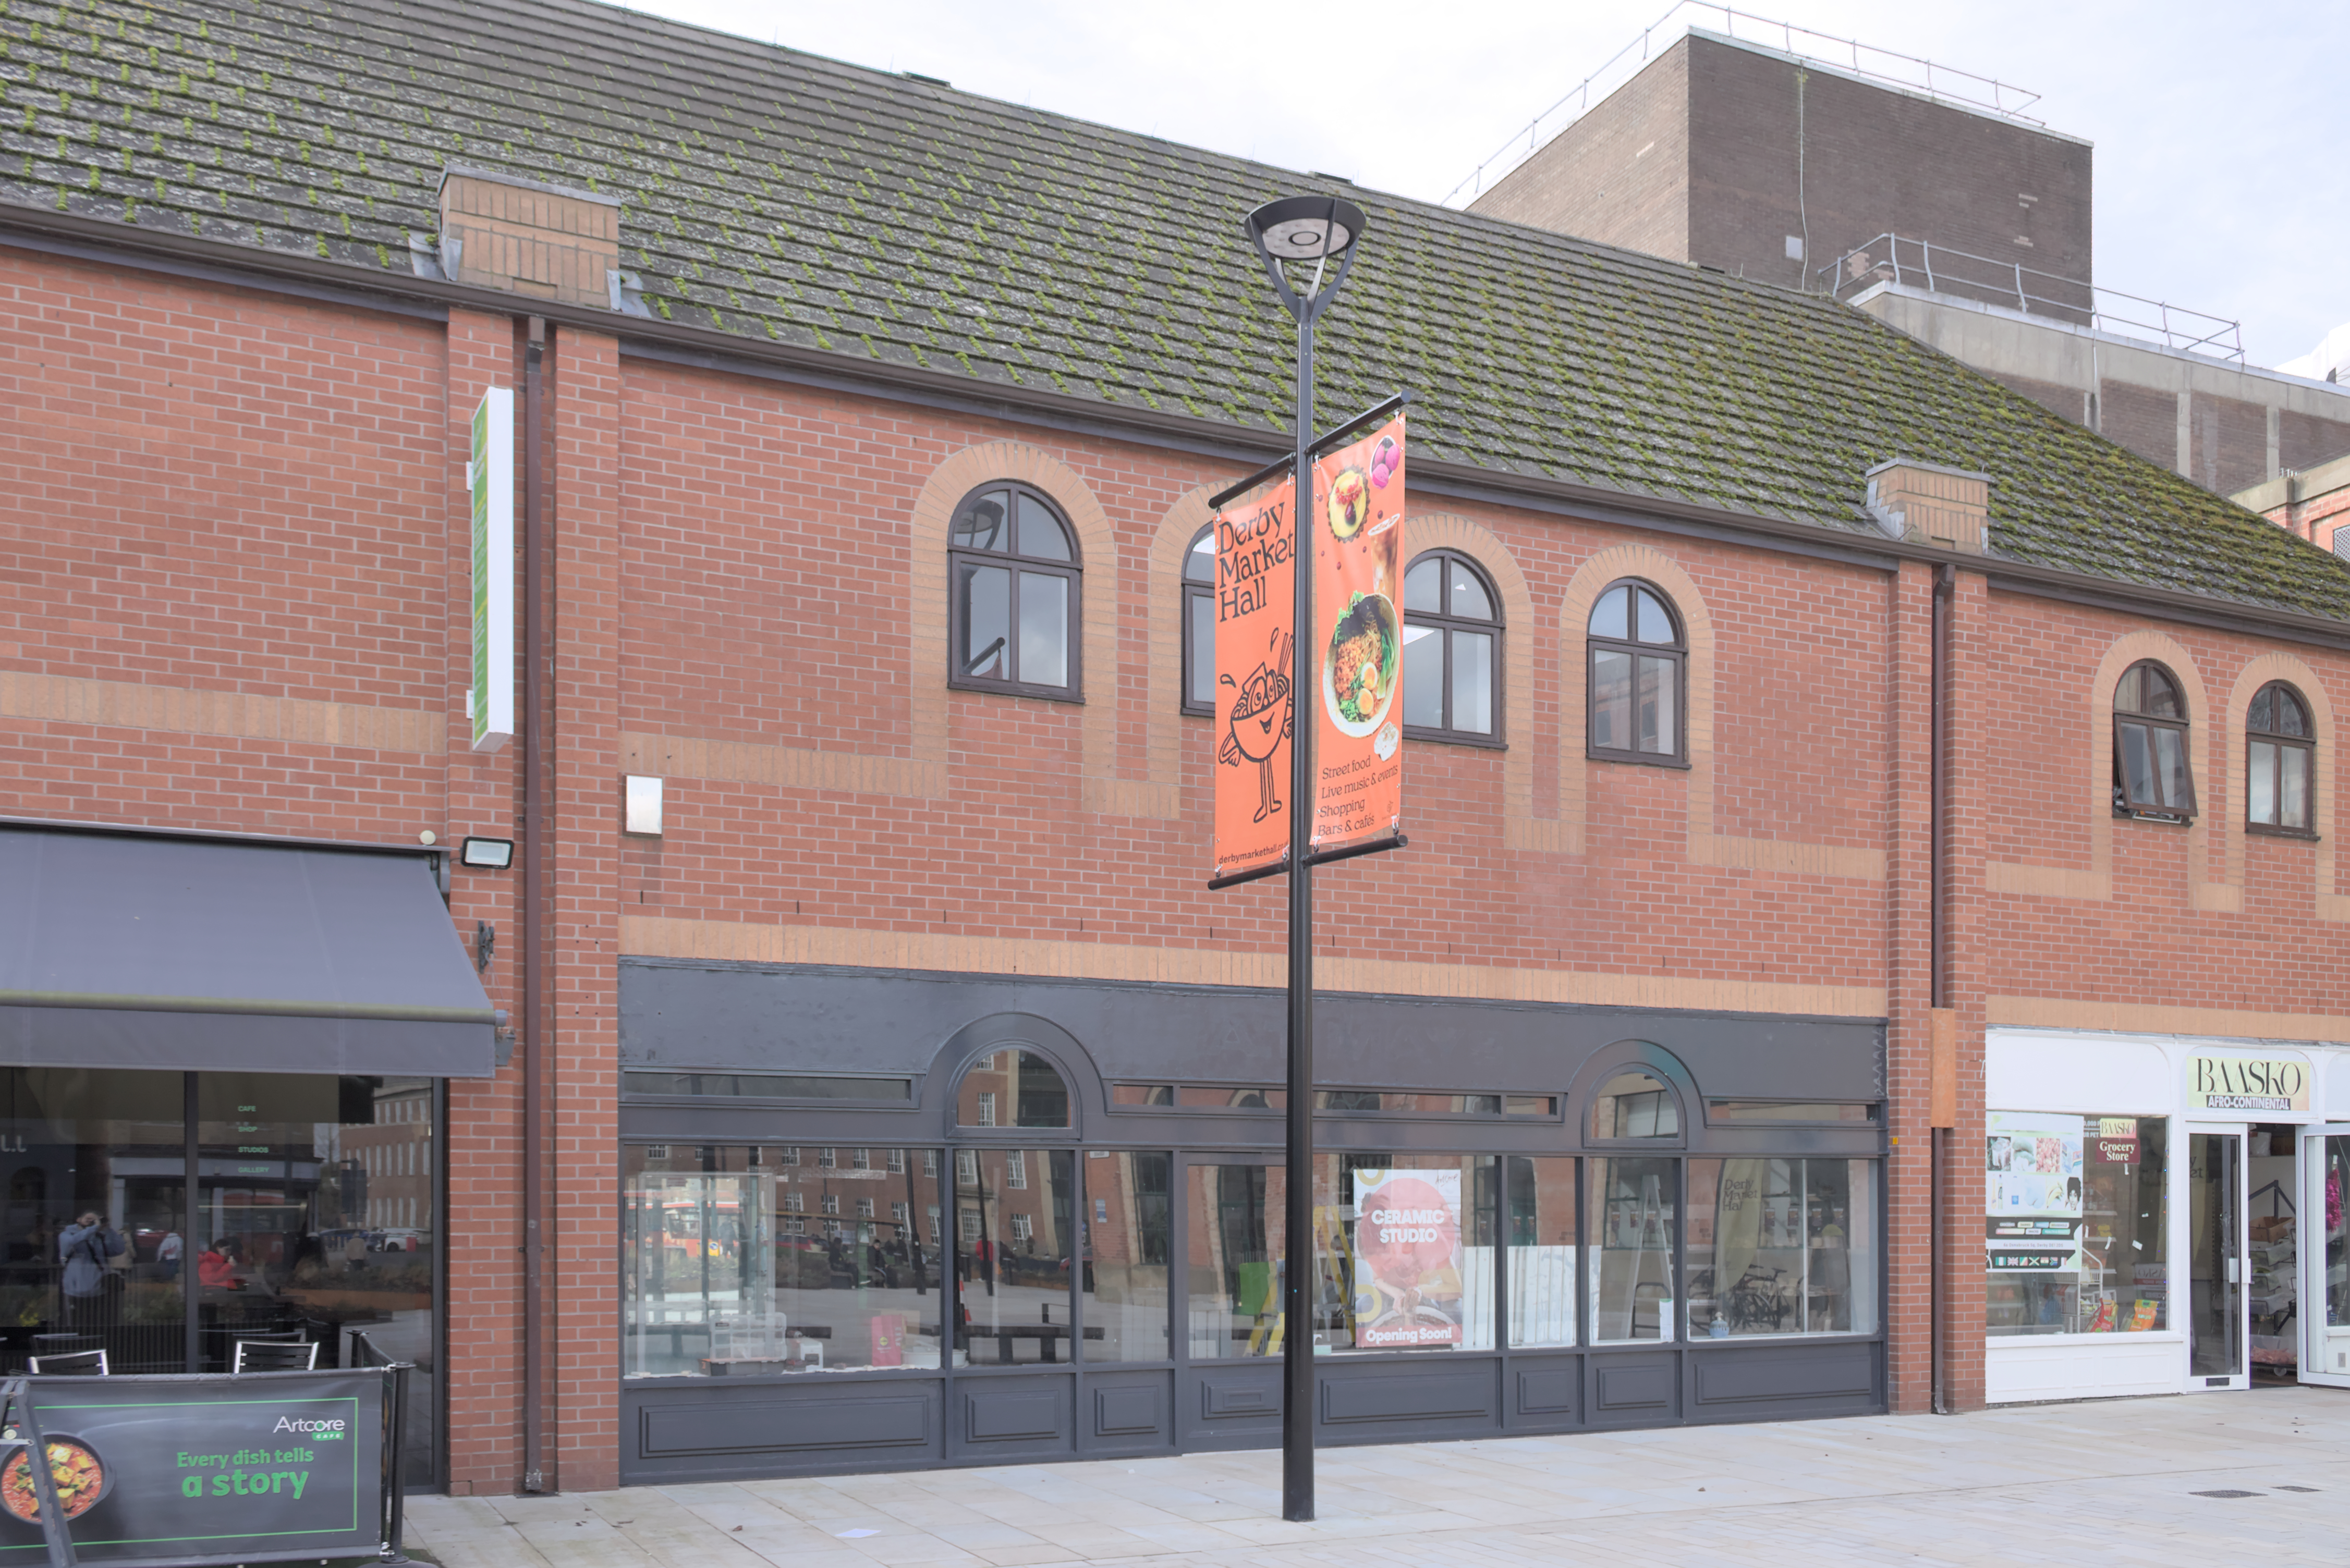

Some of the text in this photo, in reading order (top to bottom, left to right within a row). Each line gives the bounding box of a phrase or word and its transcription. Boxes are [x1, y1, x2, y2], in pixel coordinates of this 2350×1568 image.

[1219, 501, 1285, 555] Derby
[1219, 529, 1295, 589] Market
[1220, 575, 1267, 623] Hall
[1322, 755, 1371, 780] Street food
[1321, 765, 1398, 799] Live music & events
[1320, 799, 1365, 818] Shopping
[1318, 824, 1343, 836] Bars
[1345, 819, 1352, 832] &
[1354, 813, 1375, 830] cafés
[2197, 1058, 2301, 1096] BAASKO
[2208, 1095, 2290, 1110] AFRO-CONTINENTAL
[2101, 1121, 2135, 1134] BAASKO
[2099, 1141, 2136, 1154] Grocery
[2107, 1151, 2129, 1161] Store
[1371, 1209, 1445, 1225] CERAMIC
[1380, 1228, 1438, 1244] STUDIO
[1366, 1327, 1452, 1344] Opening Soon!
[273, 1416, 345, 1433] Artcore
[177, 1447, 314, 1469] Every dish tells
[181, 1469, 309, 1500] a story
